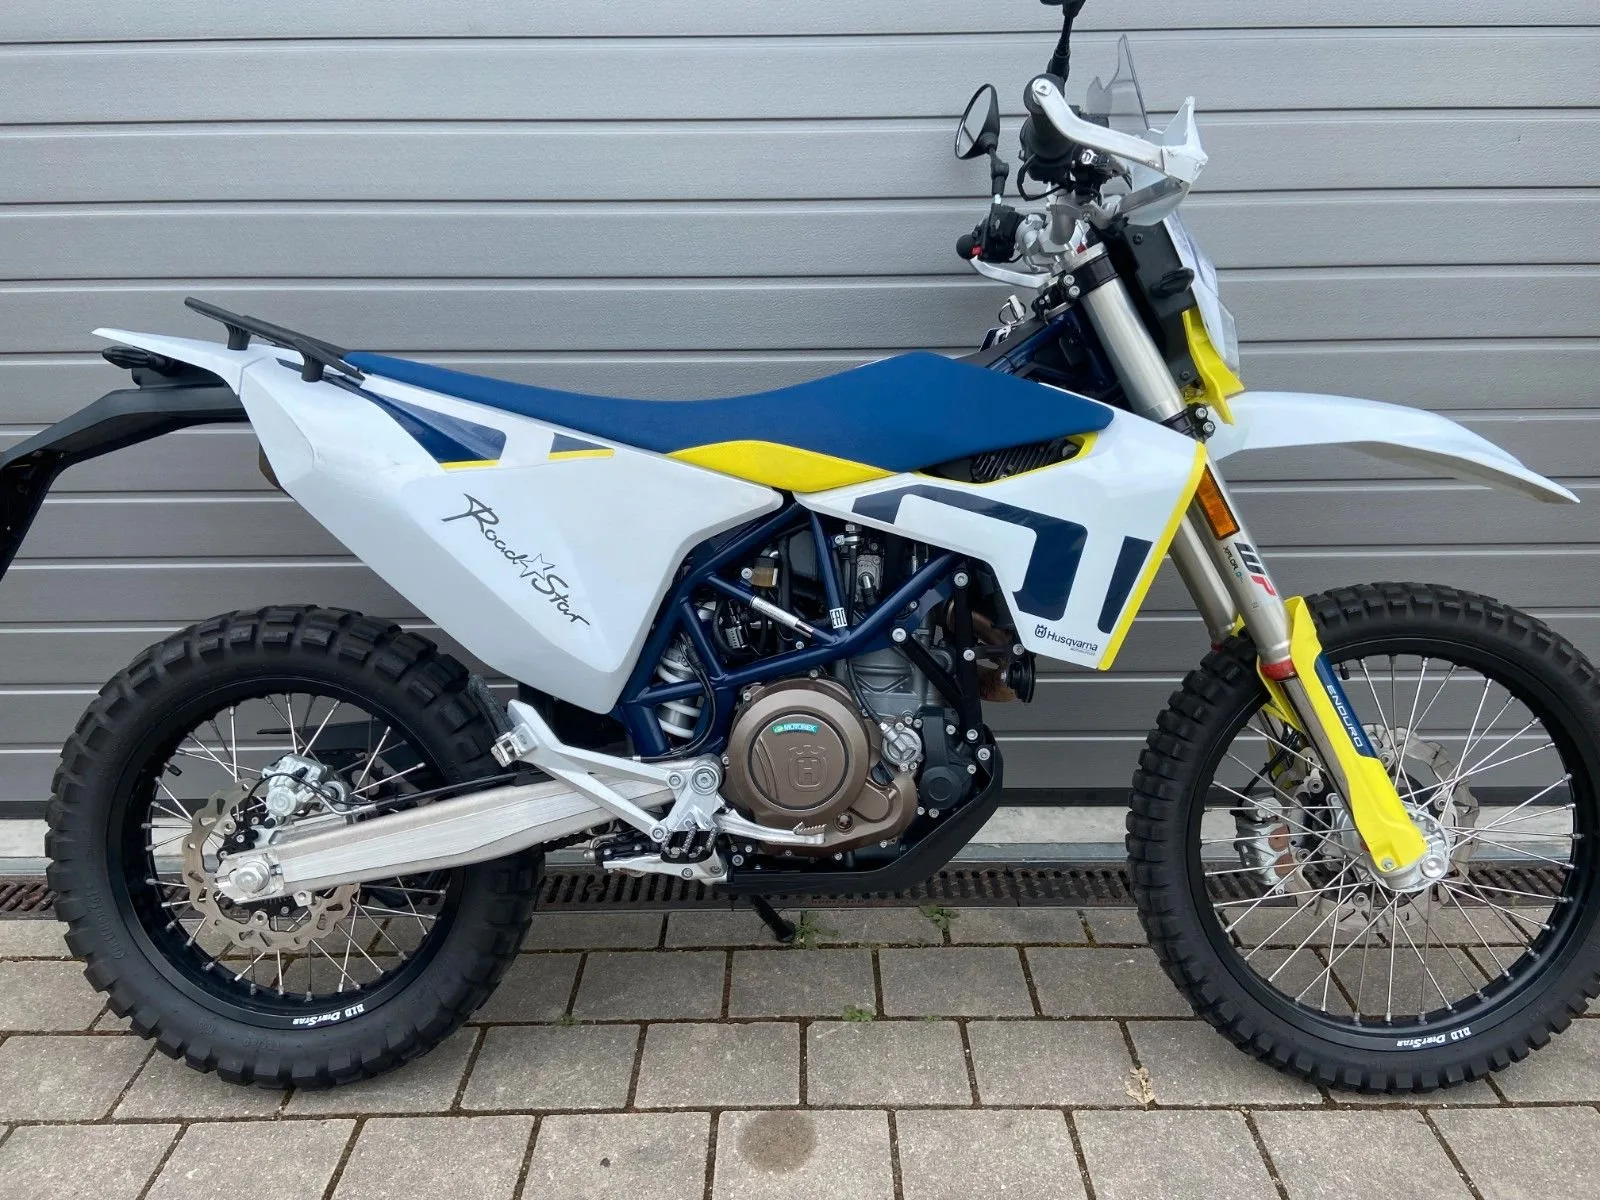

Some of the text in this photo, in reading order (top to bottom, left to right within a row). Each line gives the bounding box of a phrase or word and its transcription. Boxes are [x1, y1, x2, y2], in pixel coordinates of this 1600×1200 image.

[440, 493, 590, 626] Road Star
[1234, 543, 1277, 596] WP
[1047, 631, 1099, 652] Husqvarna
[783, 723, 817, 734] MOTOREX
[1327, 684, 1364, 748] ENDURO
